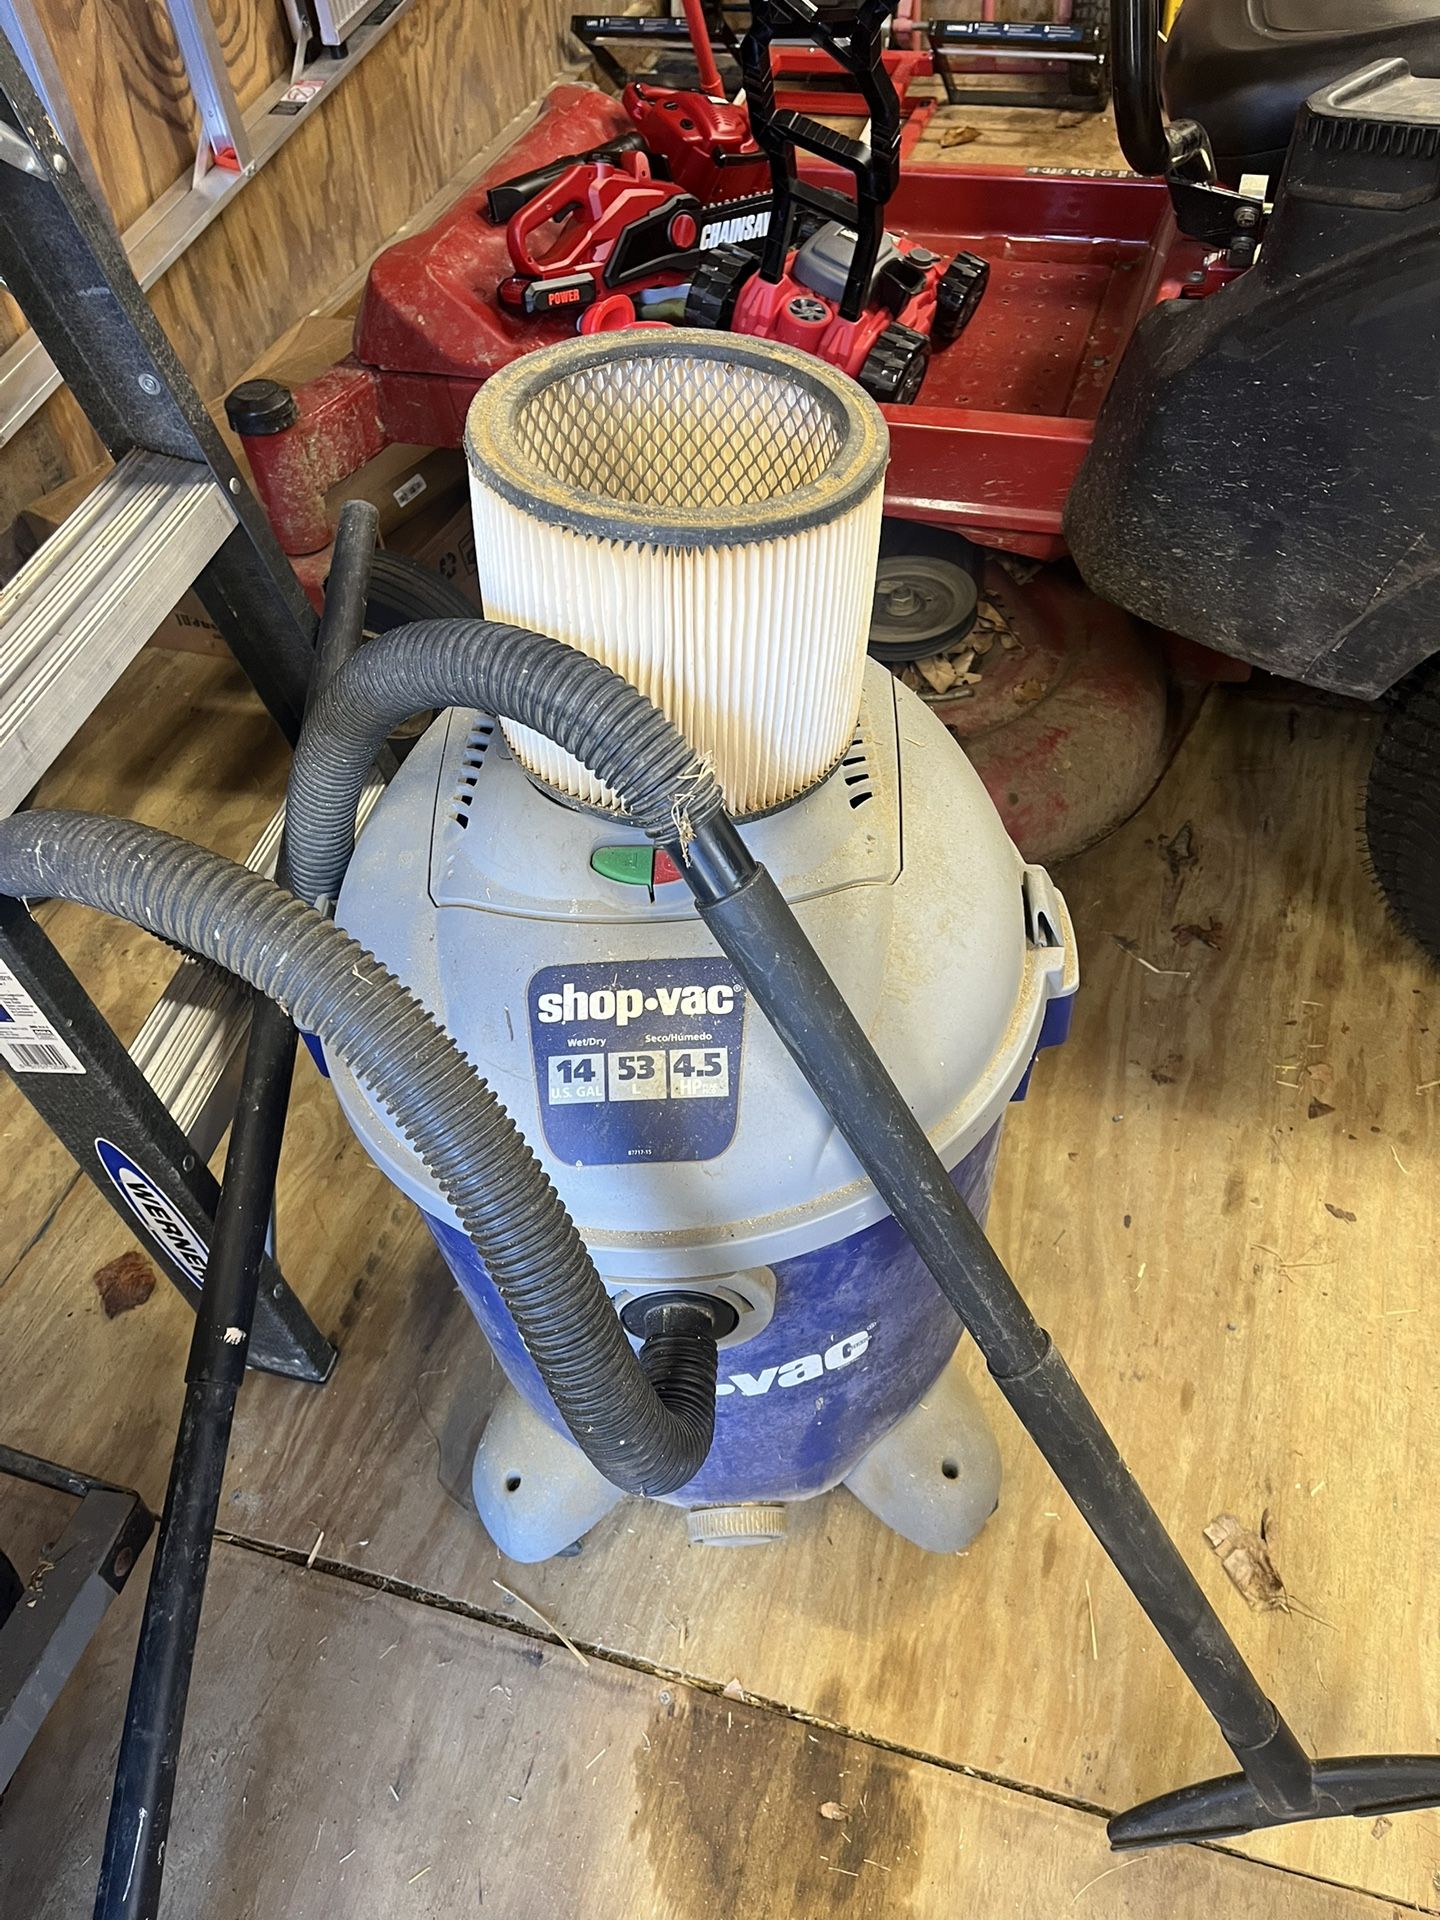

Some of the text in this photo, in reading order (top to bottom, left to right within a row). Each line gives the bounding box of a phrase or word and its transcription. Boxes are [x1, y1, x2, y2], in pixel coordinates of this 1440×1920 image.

[548, 288, 580, 306] POWER
[567, 1037, 607, 1048] Wet/Dry
[645, 1032, 713, 1043] Seco/Húmedo
[556, 1058, 596, 1083] 14
[618, 1055, 655, 1081] 53
[673, 1052, 722, 1077] 4.5
[551, 1086, 603, 1099] U.S. GAL
[632, 1083, 641, 1095] L
[680, 1079, 702, 1095] HP
[126, 1182, 207, 1279] WERNE
